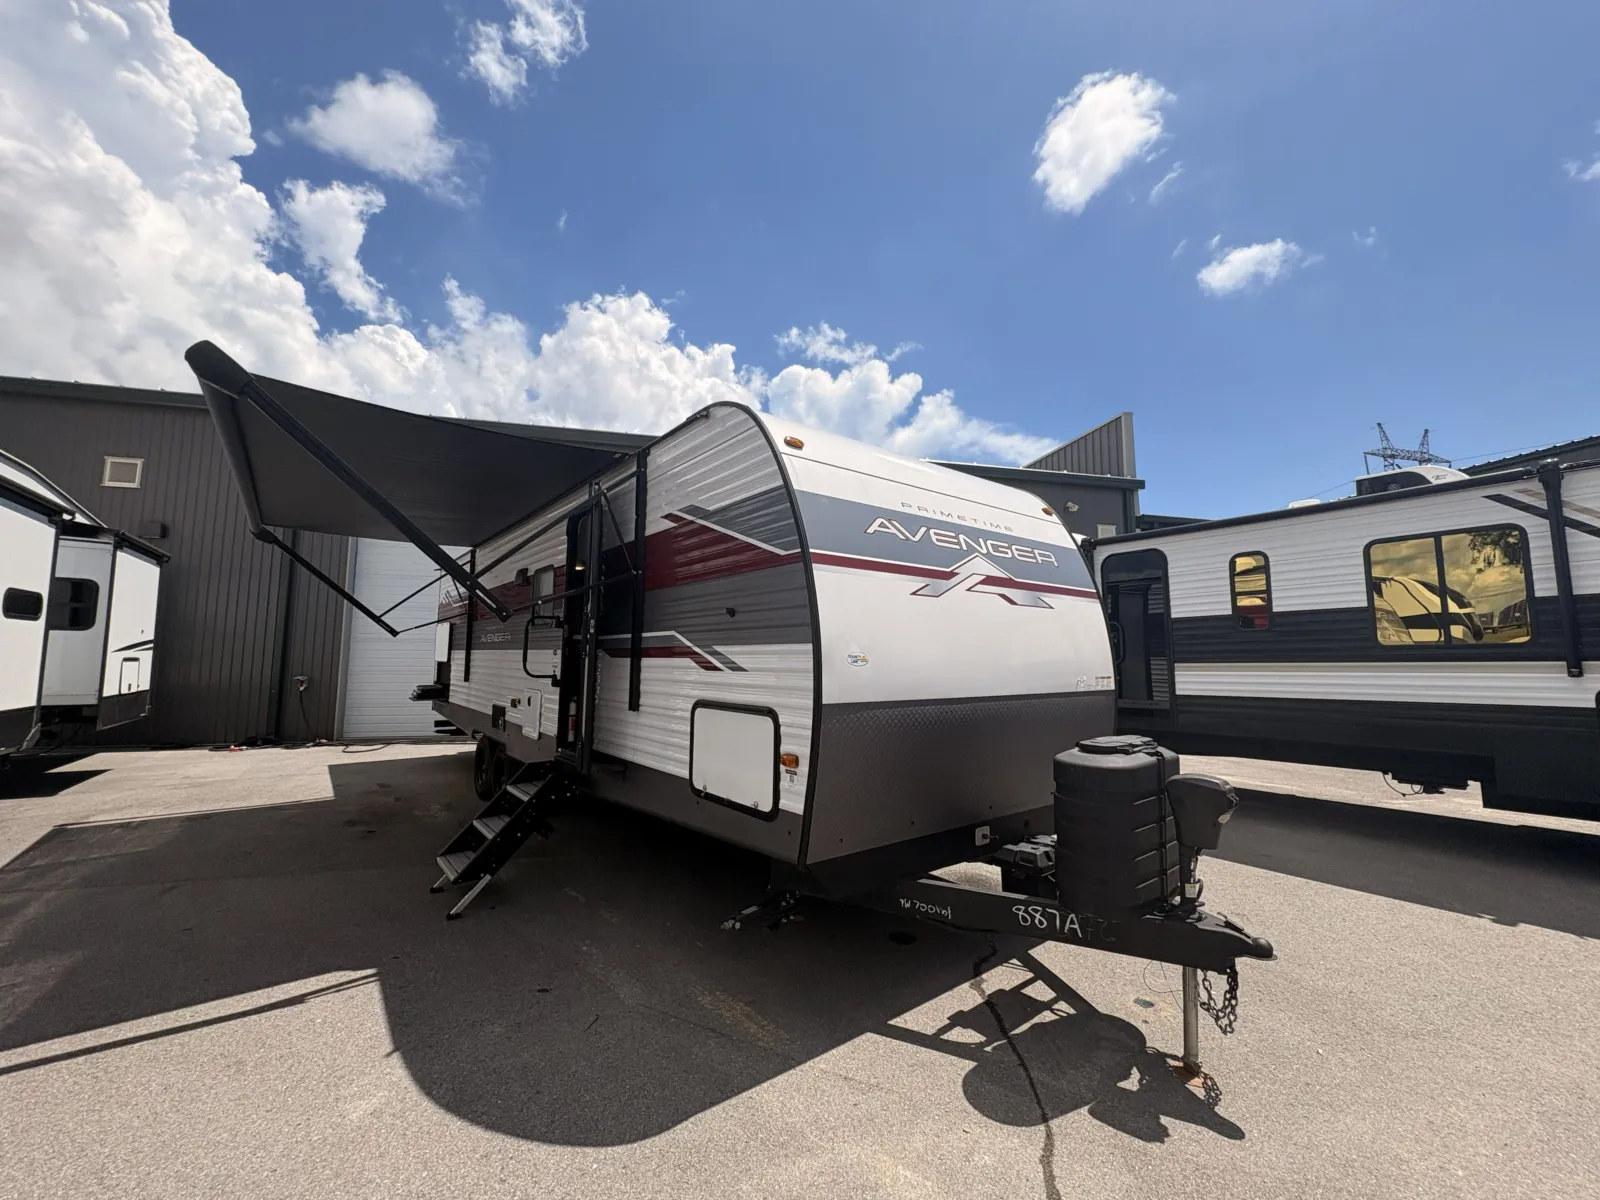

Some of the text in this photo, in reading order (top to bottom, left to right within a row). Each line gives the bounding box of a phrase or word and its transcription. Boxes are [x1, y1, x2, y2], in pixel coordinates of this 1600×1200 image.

[900, 501, 1014, 532] PRIMETIME
[864, 516, 1060, 568] AVENGER
[480, 632, 511, 642] AVENGER
